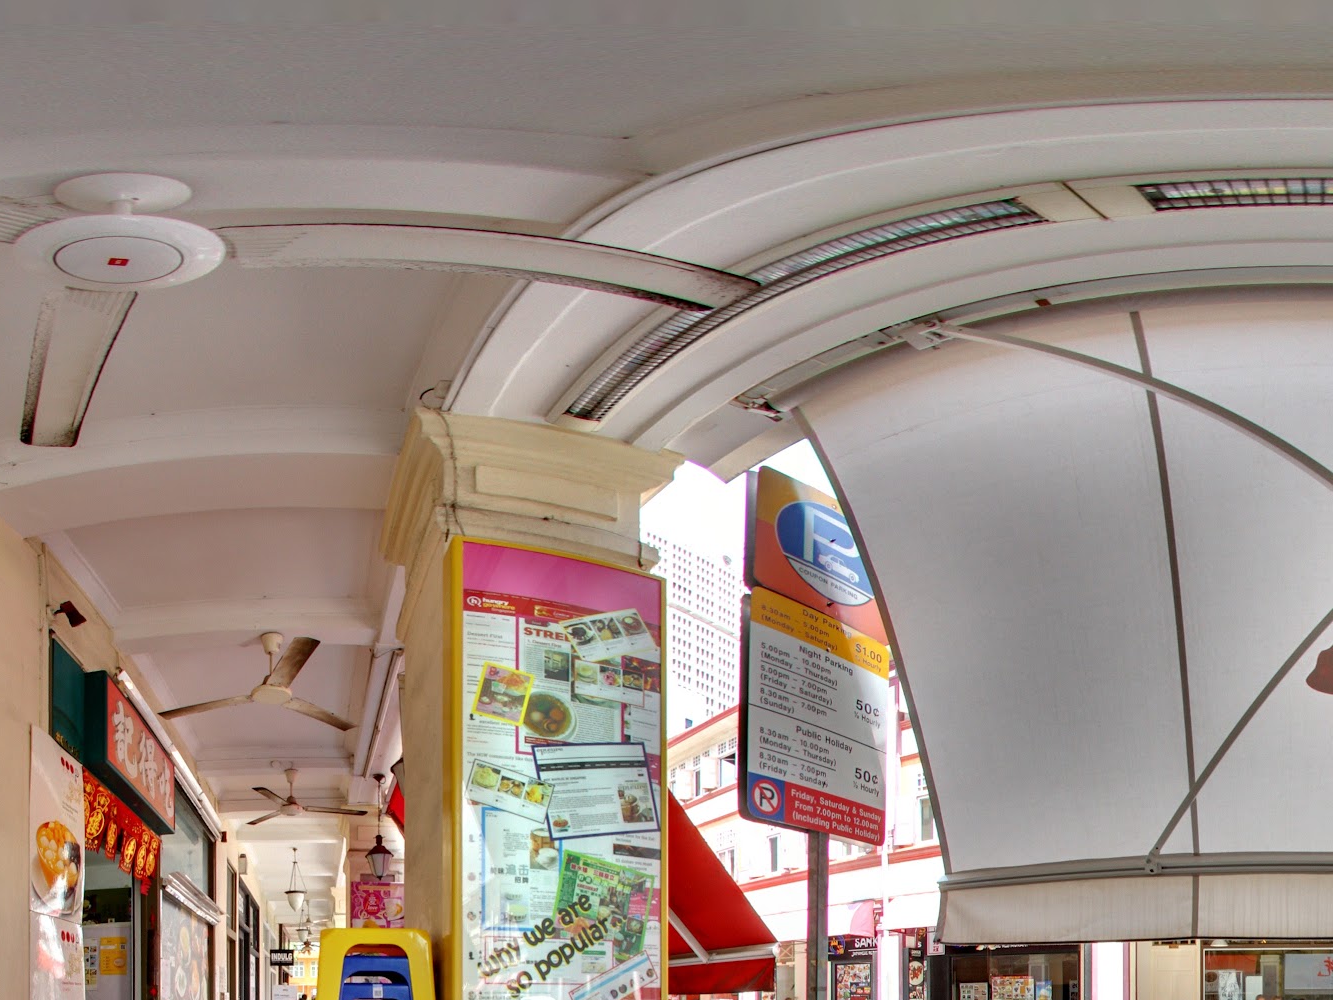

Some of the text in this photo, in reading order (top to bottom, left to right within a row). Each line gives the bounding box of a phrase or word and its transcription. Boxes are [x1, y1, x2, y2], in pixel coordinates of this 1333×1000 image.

[798, 567, 859, 600] COUPON PARKING
[482, 596, 509, 607] hungry
[761, 604, 791, 621] 8.30am
[803, 621, 830, 638] 5.00pm
[761, 613, 795, 633] (Monday
[804, 631, 838, 651] Saturday)
[802, 608, 852, 639] Day Parking
[760, 642, 791, 660] 5.00pm
[802, 659, 832, 676] 10.00pm
[760, 651, 793, 669] (Monday
[804, 667, 838, 687] Thursday)
[799, 645, 854, 677] Night Parking
[855, 643, 882, 664] $1.00
[862, 657, 882, 673] Hourly
[760, 664, 790, 681] 5.00pm
[801, 680, 828, 696] 7.00pm
[760, 674, 788, 690] (Friday
[799, 688, 833, 706] Saturday)
[760, 687, 790, 703] 8.30am
[801, 702, 828, 717] 7.00pm
[760, 696, 795, 715] (Sunday)
[861, 714, 881, 730] Hourly
[759, 726, 789, 742] 8.30am
[800, 739, 830, 755] 10.00pm
[759, 736, 792, 753] (Monday
[803, 749, 837, 767] Thursday)
[796, 725, 853, 755] Public Holiday
[759, 752, 789, 767] 8.30am
[801, 764, 827, 778] 7.00pm
[759, 761, 787, 777] (Friday
[790, 788, 817, 805] Friday,
[819, 797, 850, 815] Saturday
[859, 808, 882, 823] Sunday
[860, 782, 880, 798] Hourly
[792, 811, 880, 842] (Including Public Holiday)
[794, 800, 879, 831] From 7.00pm to 12.00am
[477, 894, 593, 977] why we are
[506, 971, 533, 998] so
